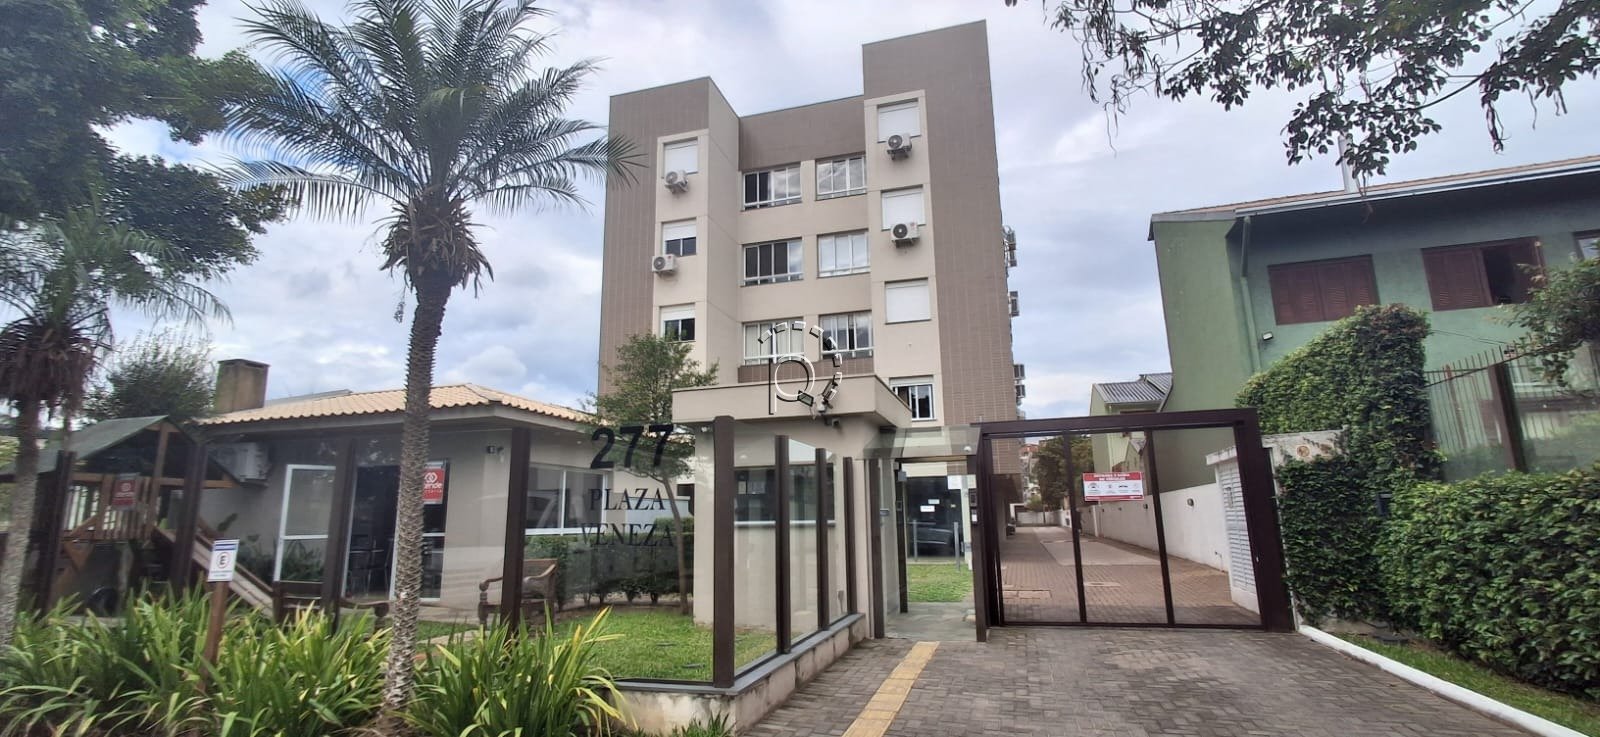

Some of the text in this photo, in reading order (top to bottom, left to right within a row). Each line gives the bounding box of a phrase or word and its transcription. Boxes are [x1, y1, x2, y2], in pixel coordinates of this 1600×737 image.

[591, 425, 673, 469] 277
[588, 488, 666, 511] PLAZA
[580, 523, 674, 547] VENEZA
[220, 555, 228, 566] E
